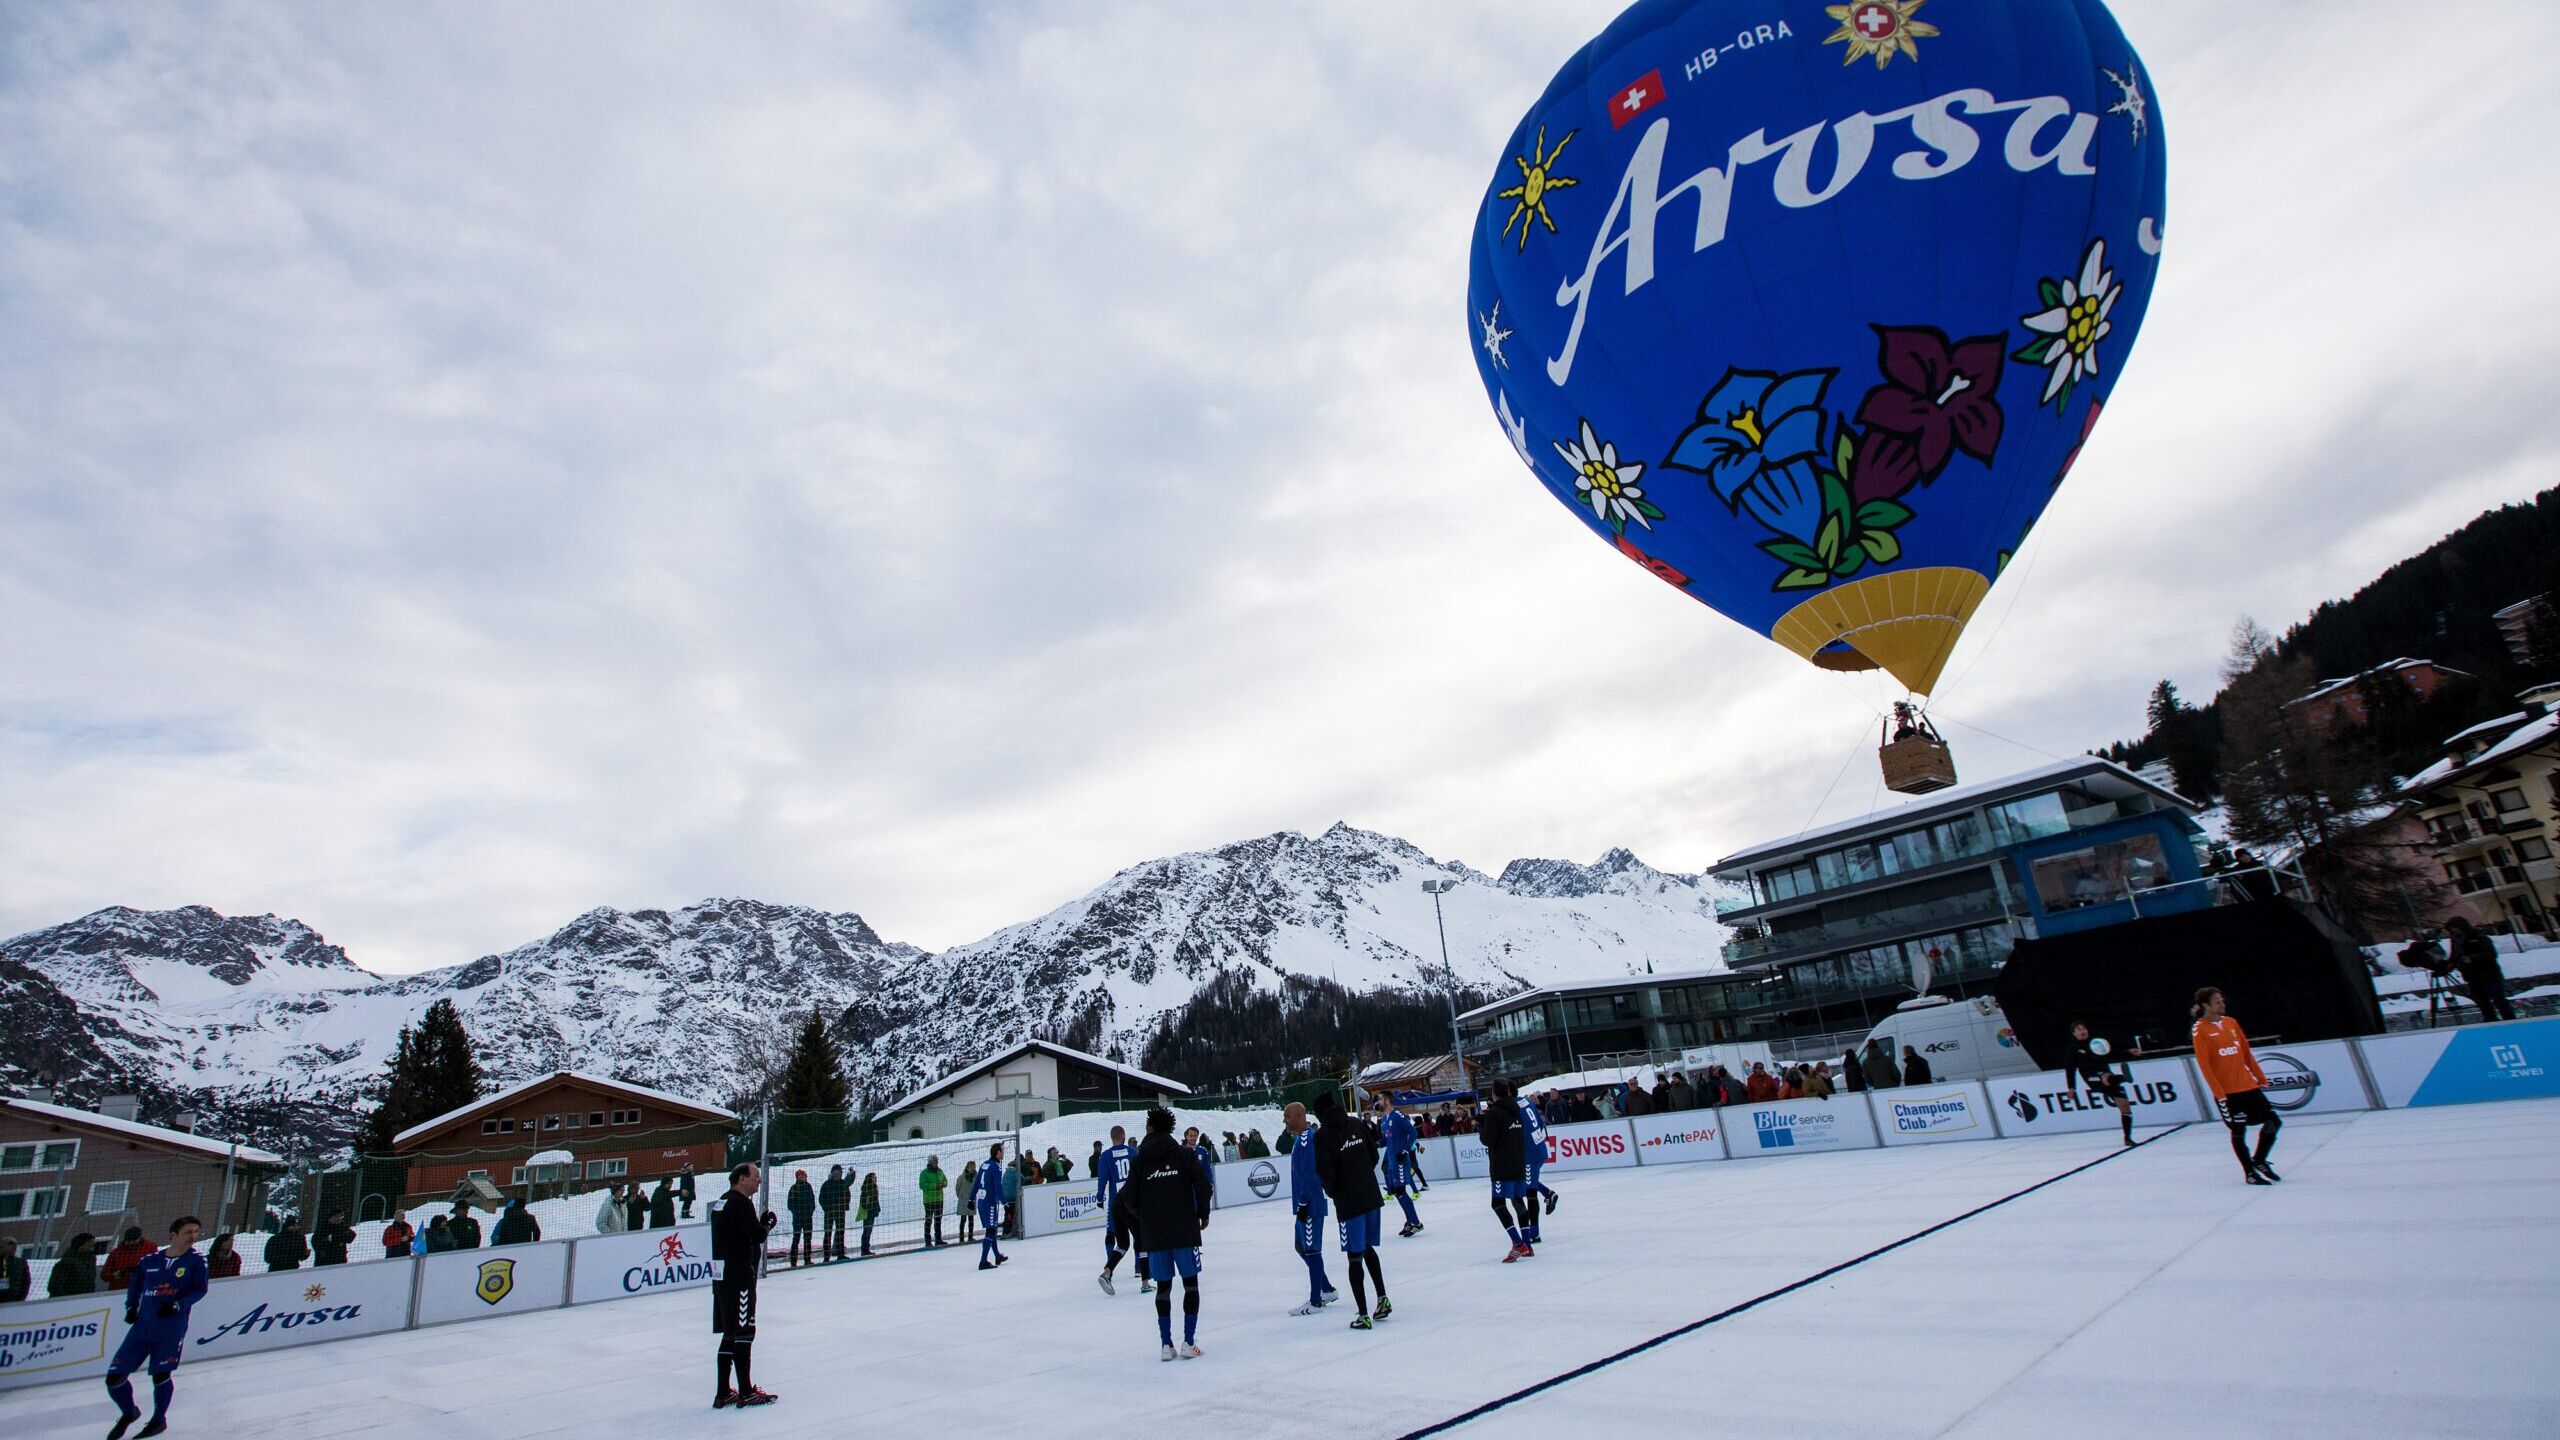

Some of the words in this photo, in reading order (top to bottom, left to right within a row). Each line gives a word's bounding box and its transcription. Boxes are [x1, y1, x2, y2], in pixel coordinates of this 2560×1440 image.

[1685, 20, 1793, 81] HB-QRA
[1546, 88, 2097, 387] Arosa
[1526, 1107, 1538, 1127] 9
[1894, 1101, 1965, 1117] Champions
[1757, 1111, 1797, 1129] Blue
[1799, 1113, 1834, 1125] service
[1898, 1117, 1927, 1131] Club
[1560, 1134, 1625, 1157] SWISS
[1663, 1129, 1716, 1145] AntePAY
[1115, 1158, 1130, 1180] 10
[1147, 1169, 1178, 1180] Arosa
[1059, 1193, 1107, 1208] Champios
[1059, 1207, 1080, 1220] Club
[623, 1262, 713, 1292] CALANDA
[196, 1303, 363, 1345] Arosa
